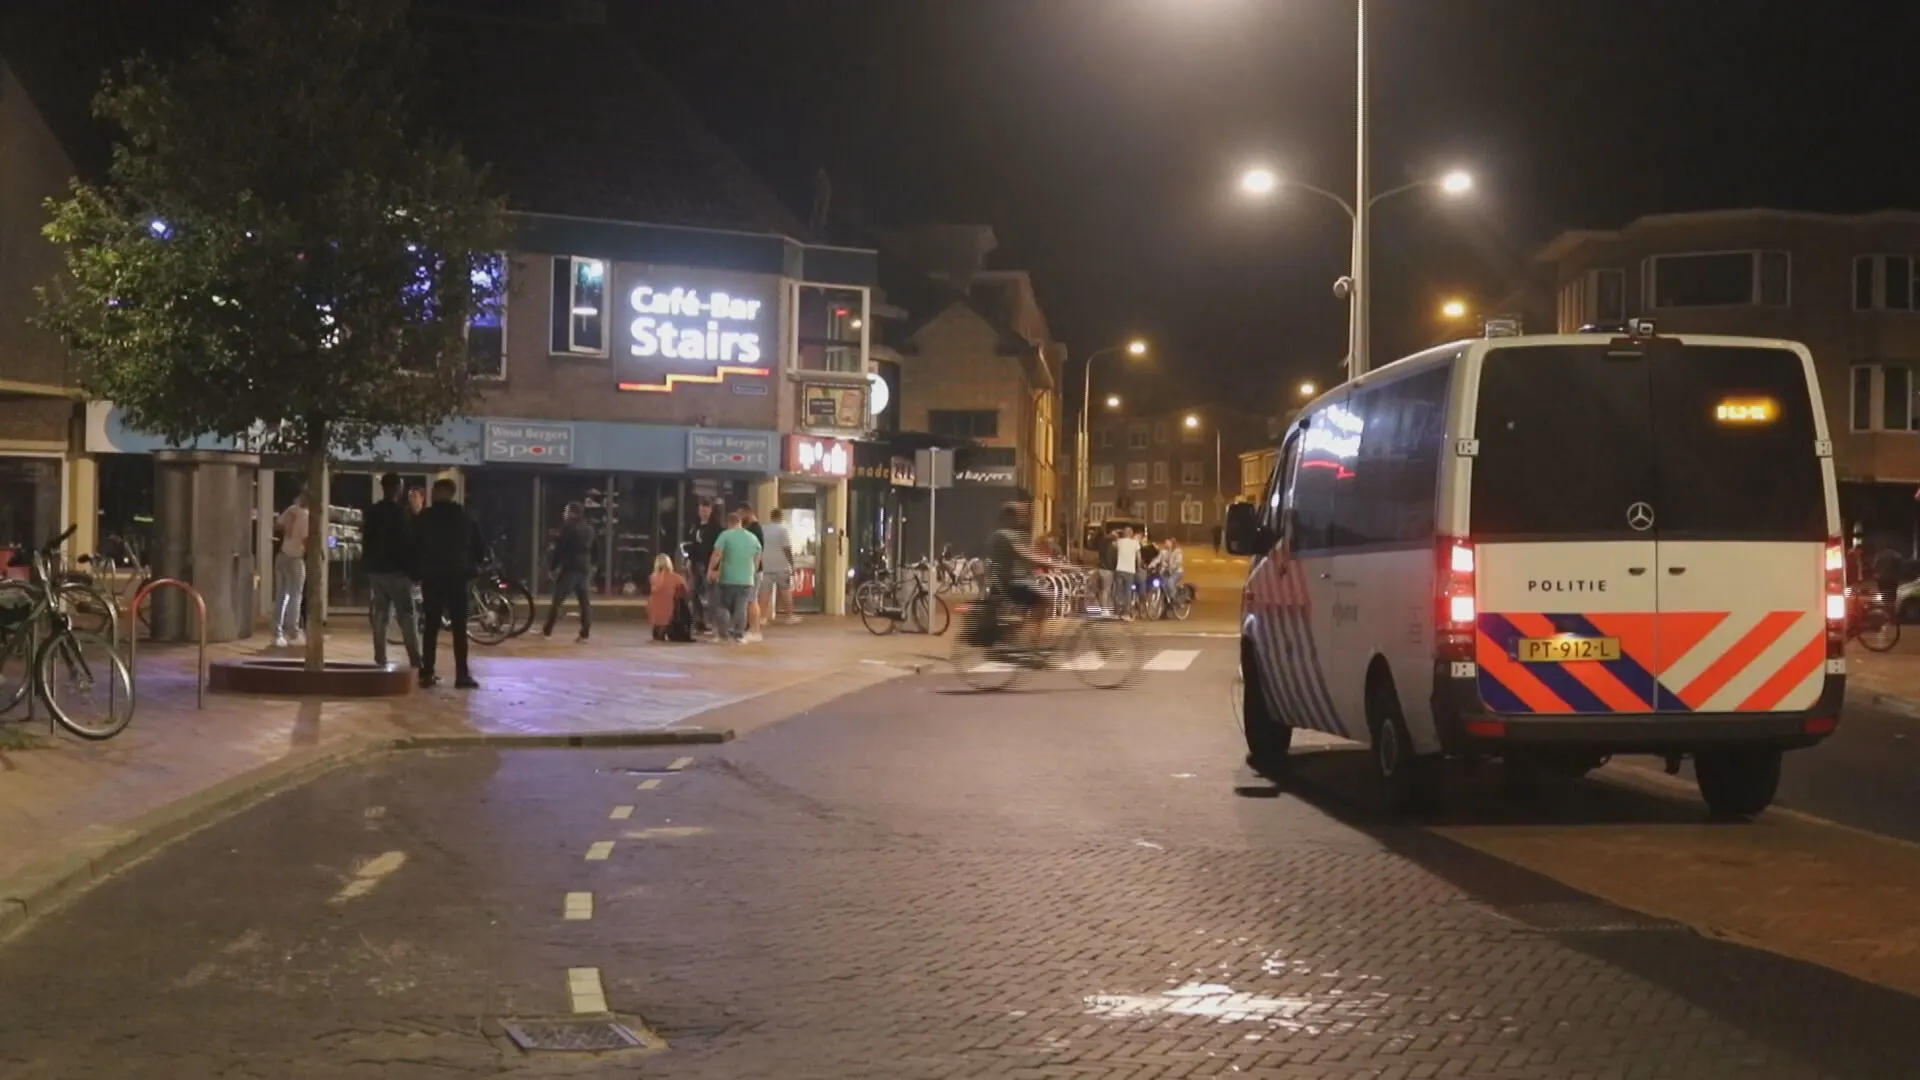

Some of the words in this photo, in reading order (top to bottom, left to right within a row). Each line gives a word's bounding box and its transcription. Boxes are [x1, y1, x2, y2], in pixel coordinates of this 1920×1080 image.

[630, 285, 761, 321] Café-Bar
[630, 316, 761, 363] Stairs
[525, 428, 568, 442] Bergers
[491, 440, 567, 458] Sport
[695, 448, 766, 465] Sport
[1528, 580, 1607, 592] POLITIE
[1529, 641, 1611, 659] PT-912-L
